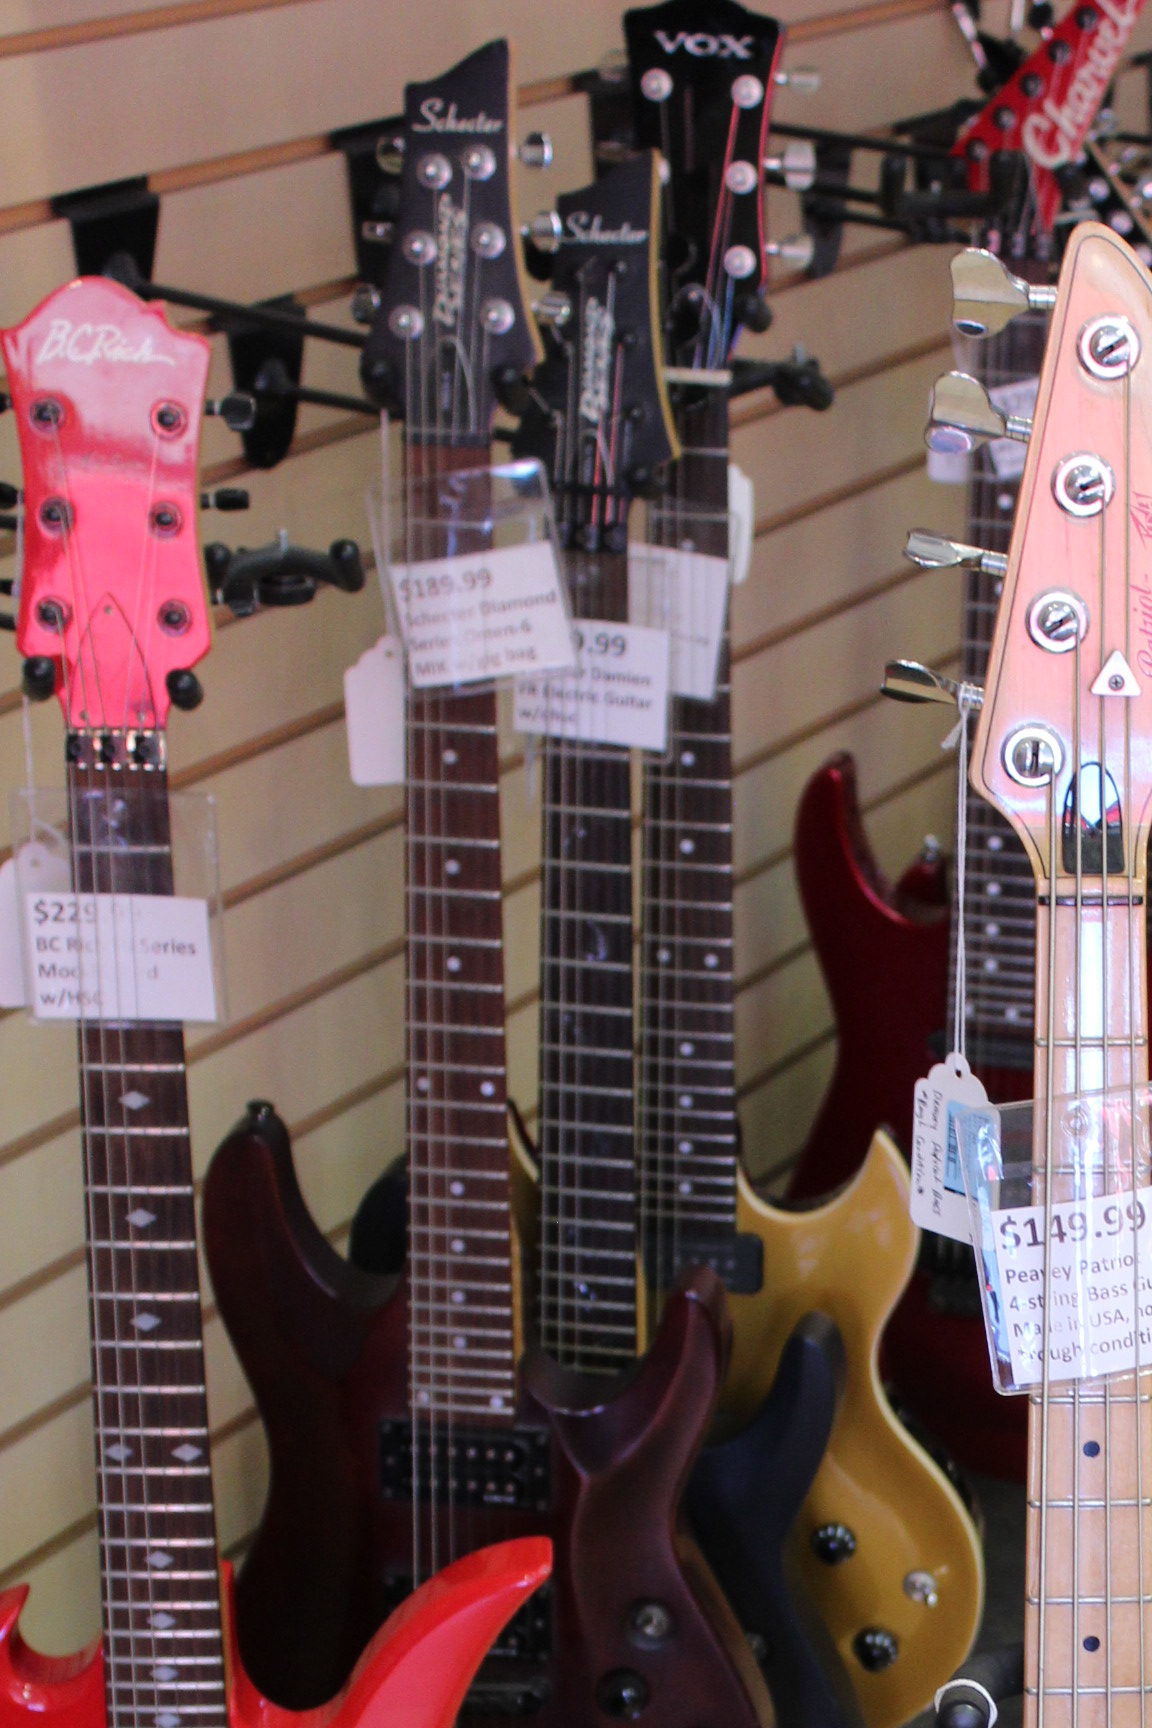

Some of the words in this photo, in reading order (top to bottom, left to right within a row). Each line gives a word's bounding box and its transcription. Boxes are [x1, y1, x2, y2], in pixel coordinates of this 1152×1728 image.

[654, 29, 756, 59] VOX
[411, 98, 504, 133] Schecter
[561, 210, 649, 244] Schecter
[479, 590, 558, 616] Diamond
[408, 634, 455, 652] Serie
[505, 645, 537, 662] bag
[590, 666, 651, 686] Damien
[604, 692, 652, 709] Guitar
[36, 936, 60, 953] BC
[139, 936, 197, 956] Series
[999, 1200, 1147, 1251] $149.99
[1079, 1252, 1142, 1276] Patrio
[1009, 1290, 1079, 1312] 4-sting
[1088, 1282, 1129, 1302] Bass
[1013, 1320, 1064, 1339] Mae
[1089, 1307, 1130, 1328] USA,
